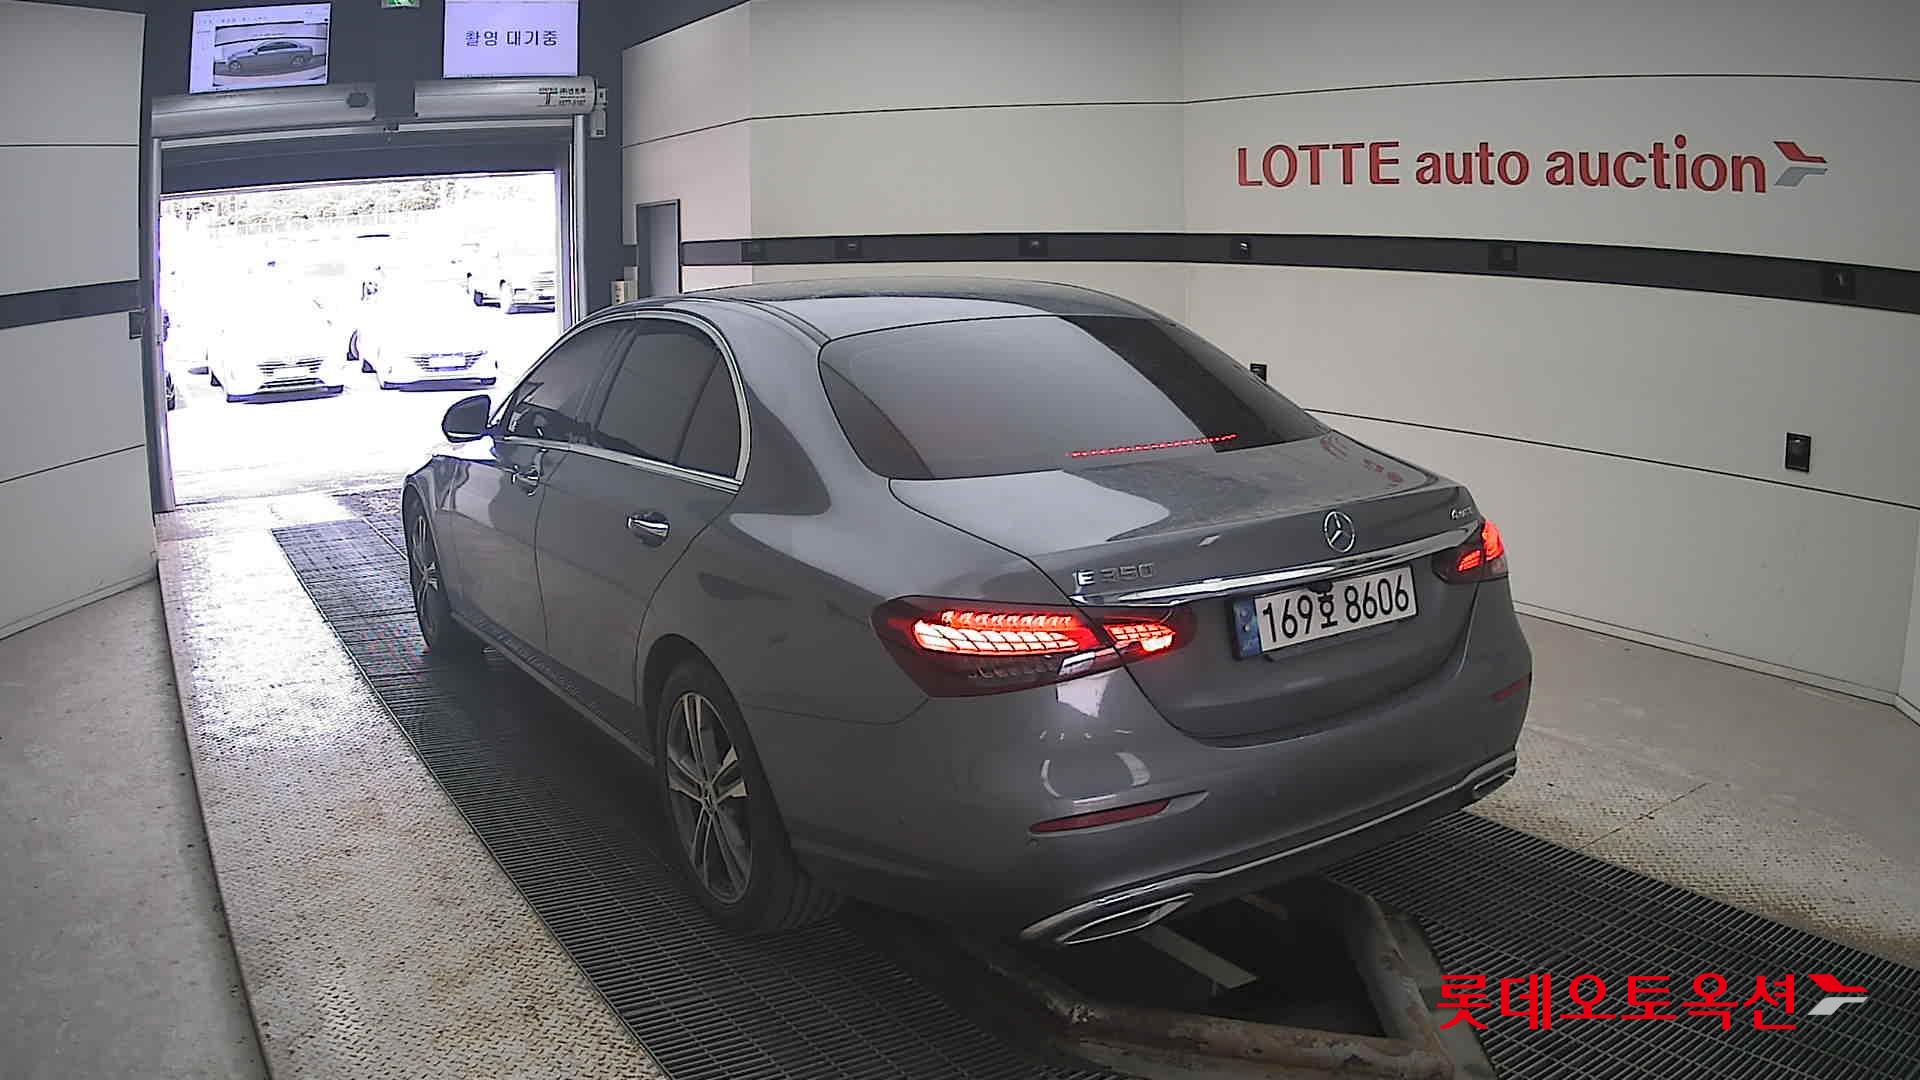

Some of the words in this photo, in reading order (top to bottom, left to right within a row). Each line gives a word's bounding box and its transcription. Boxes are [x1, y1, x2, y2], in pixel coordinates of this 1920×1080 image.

[506, 30, 558, 47] 대기중
[1237, 141, 1400, 188] LOTTE
[1415, 142, 1530, 186] auto
[1546, 134, 1767, 193] auction
[1076, 569, 1096, 587] E
[1100, 562, 1155, 583] 350
[1262, 592, 1338, 643] 169호
[1344, 574, 1410, 624] 8606
